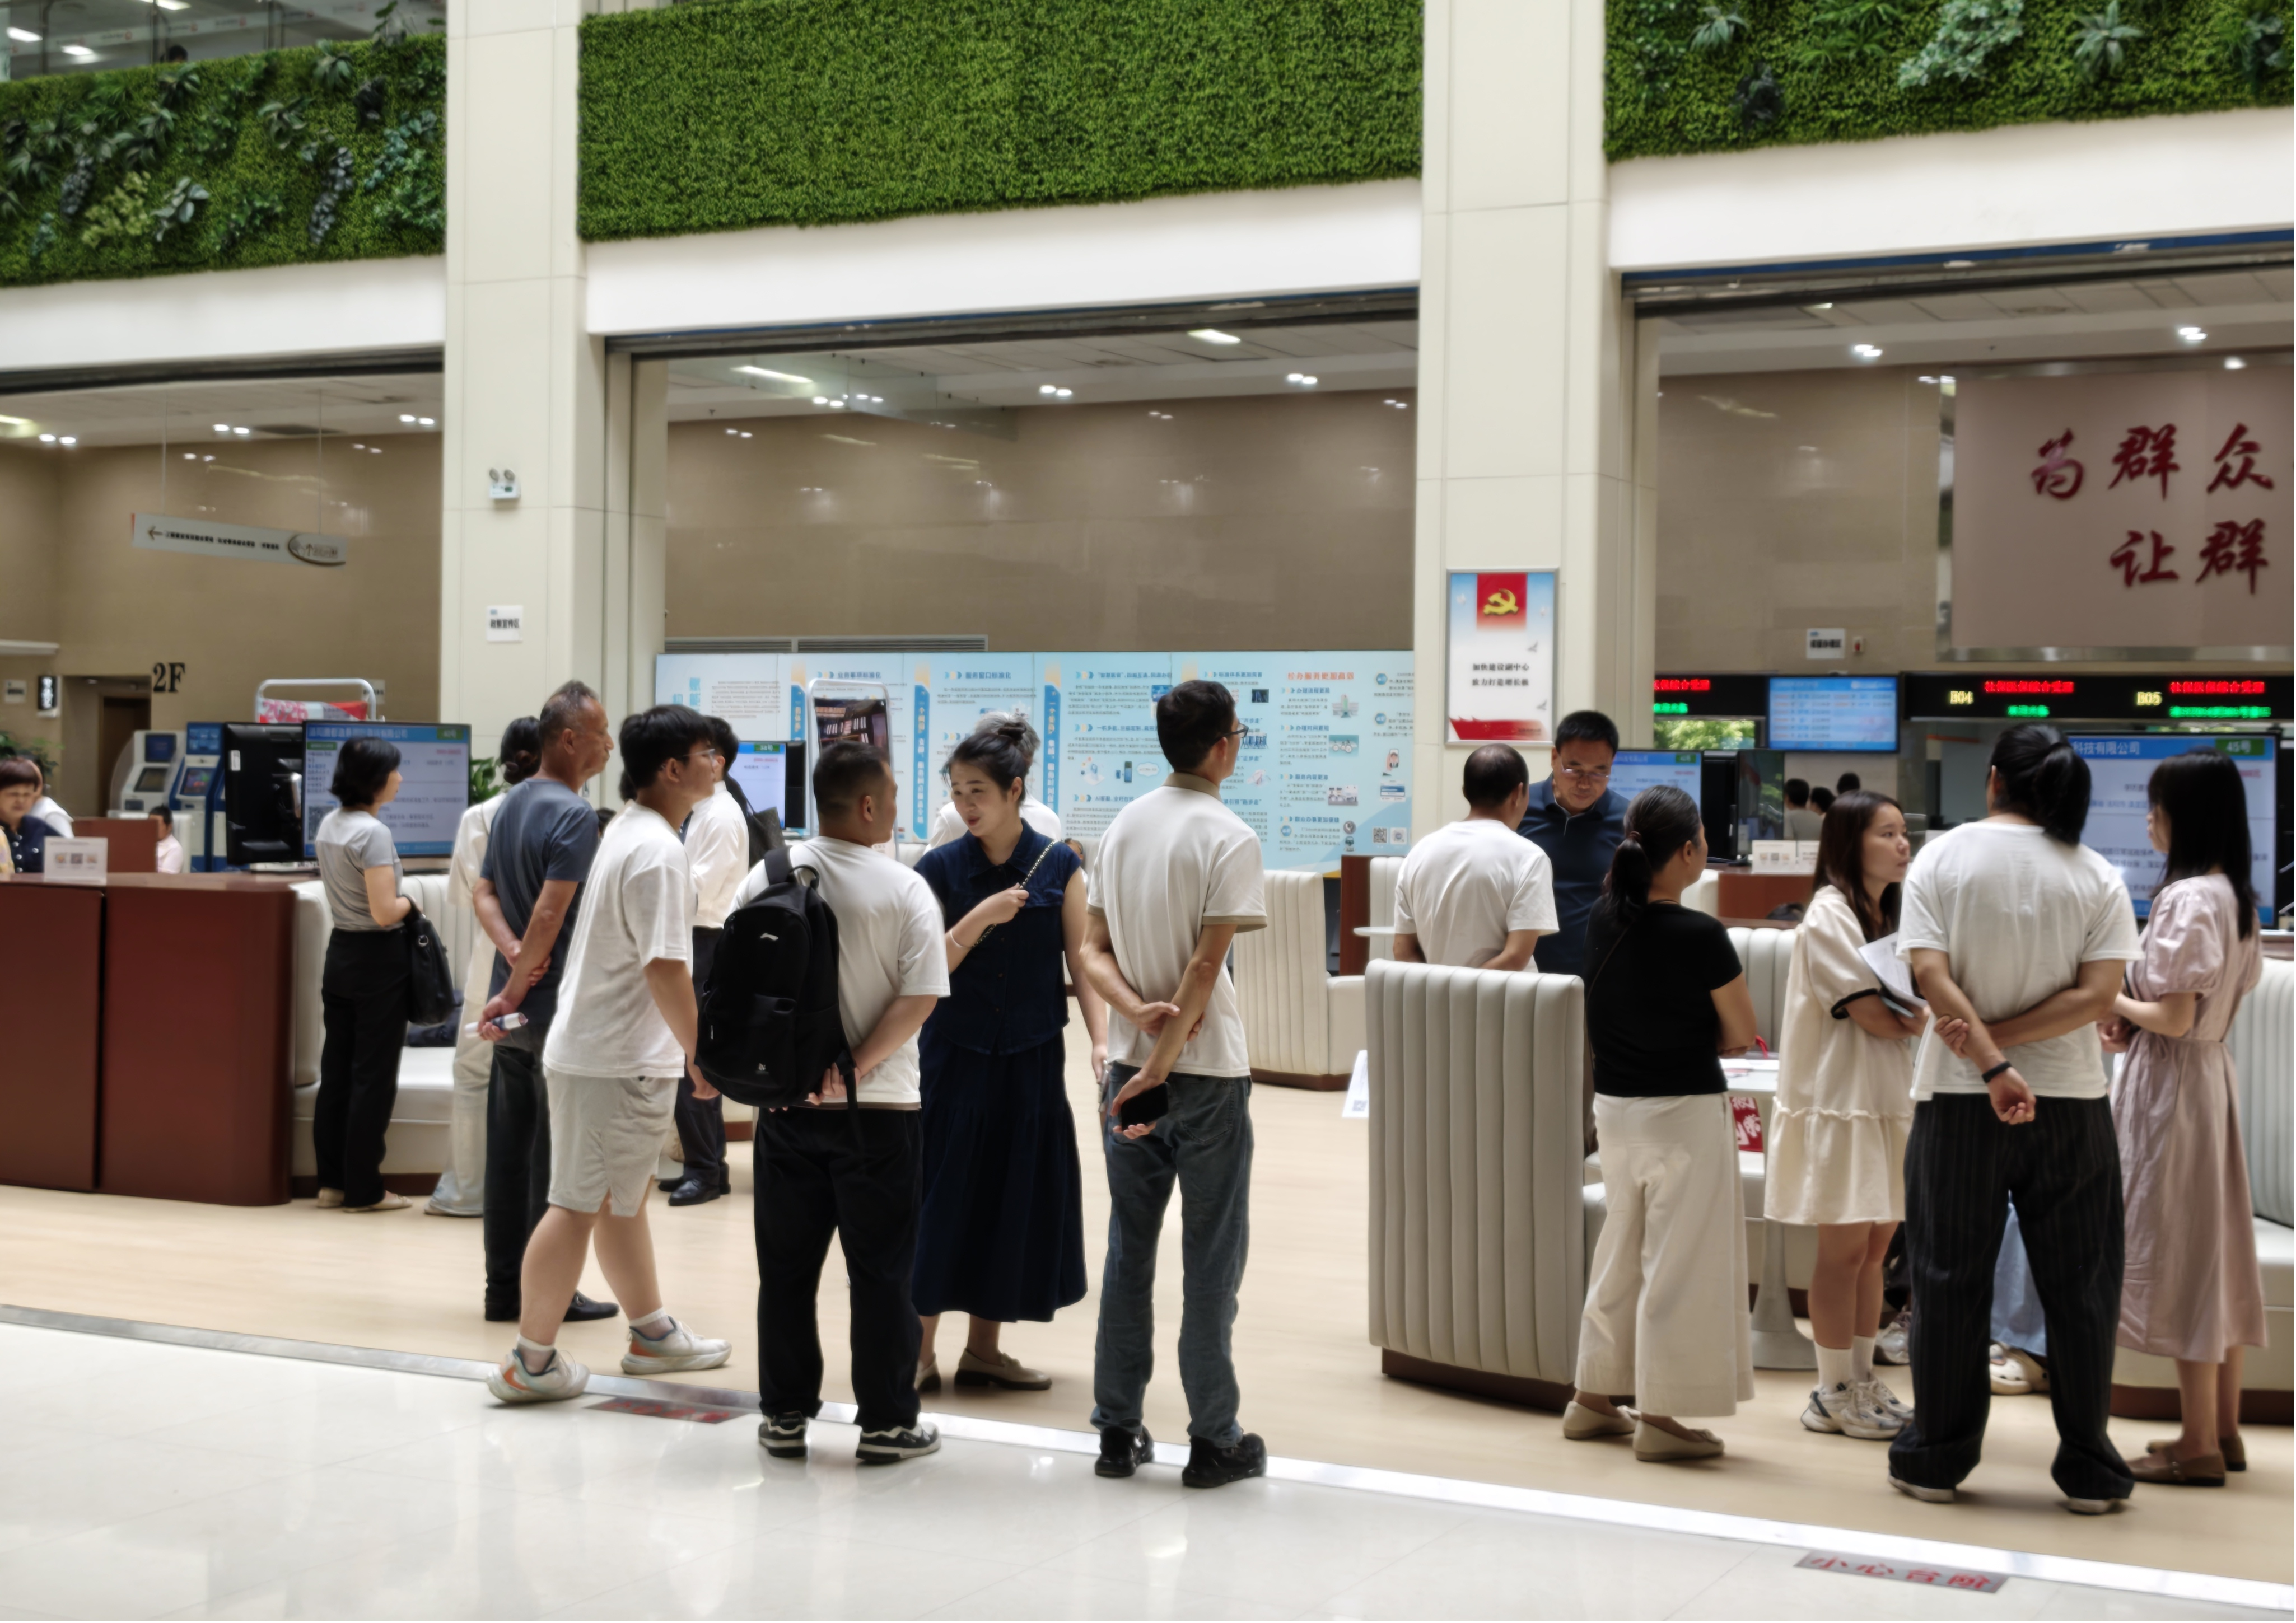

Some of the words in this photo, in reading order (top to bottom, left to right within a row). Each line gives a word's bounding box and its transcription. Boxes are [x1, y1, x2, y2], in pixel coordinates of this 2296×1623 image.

[2110, 518, 2269, 595] 让群
[153, 662, 185, 692] 2F
[1811, 1556, 1992, 1590] 小心台阶
